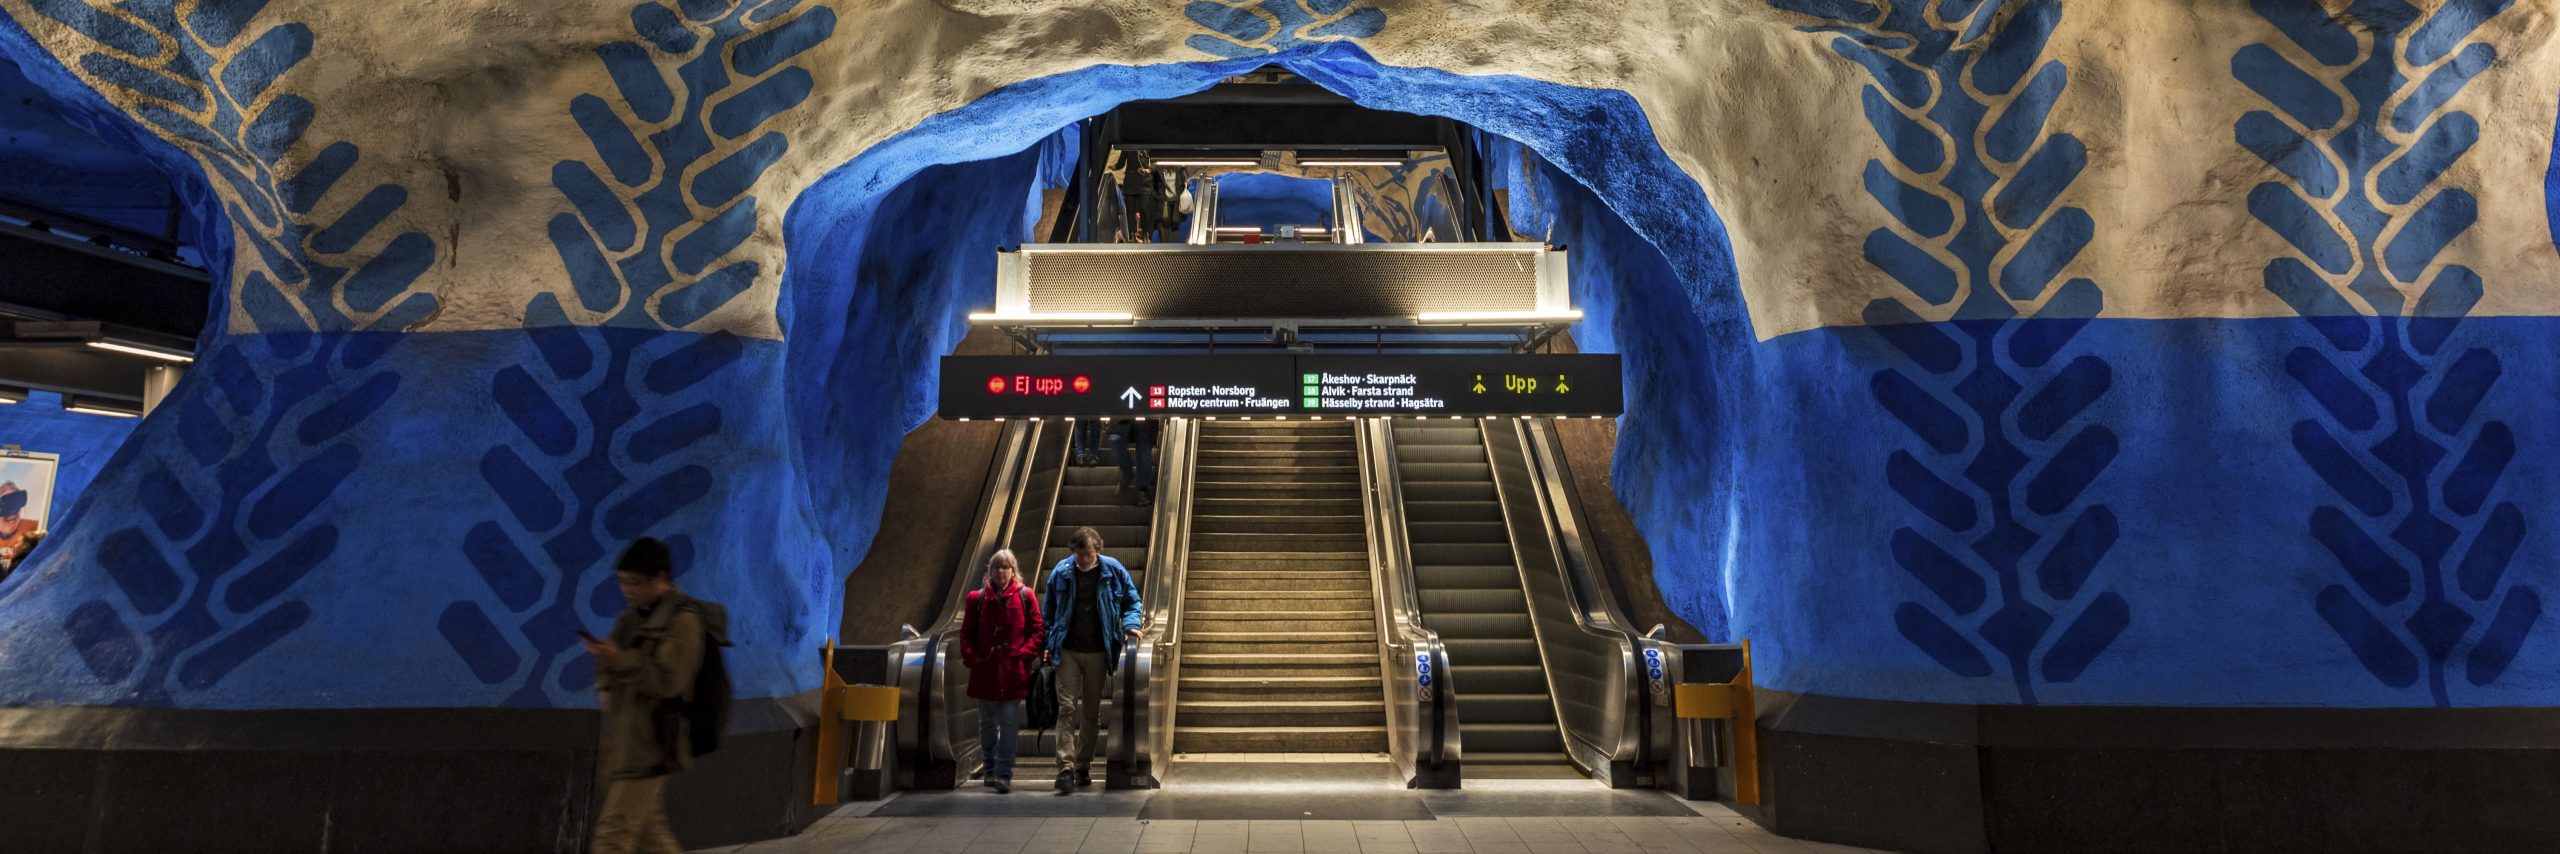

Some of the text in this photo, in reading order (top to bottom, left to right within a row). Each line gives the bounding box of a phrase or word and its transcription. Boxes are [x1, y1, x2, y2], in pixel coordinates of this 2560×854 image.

[1321, 373, 1360, 384] Åkeshov
[1366, 374, 1416, 385] Skarpnäck
[1505, 374, 1537, 394] Upp
[1015, 376, 1063, 395] Ej upp
[1168, 386, 1206, 396] Ropsten
[1212, 386, 1255, 397] Norsborg
[1321, 386, 1346, 396] Alvik
[1351, 386, 1382, 396] Farsta
[1383, 386, 1414, 396] strand
[1168, 397, 1198, 409] Mörby
[1199, 397, 1239, 408] centrum
[1245, 397, 1290, 409] Fruängen
[1321, 397, 1363, 409] Hässelby
[1364, 397, 1395, 408] strand
[1401, 397, 1444, 409] Hagsätra
